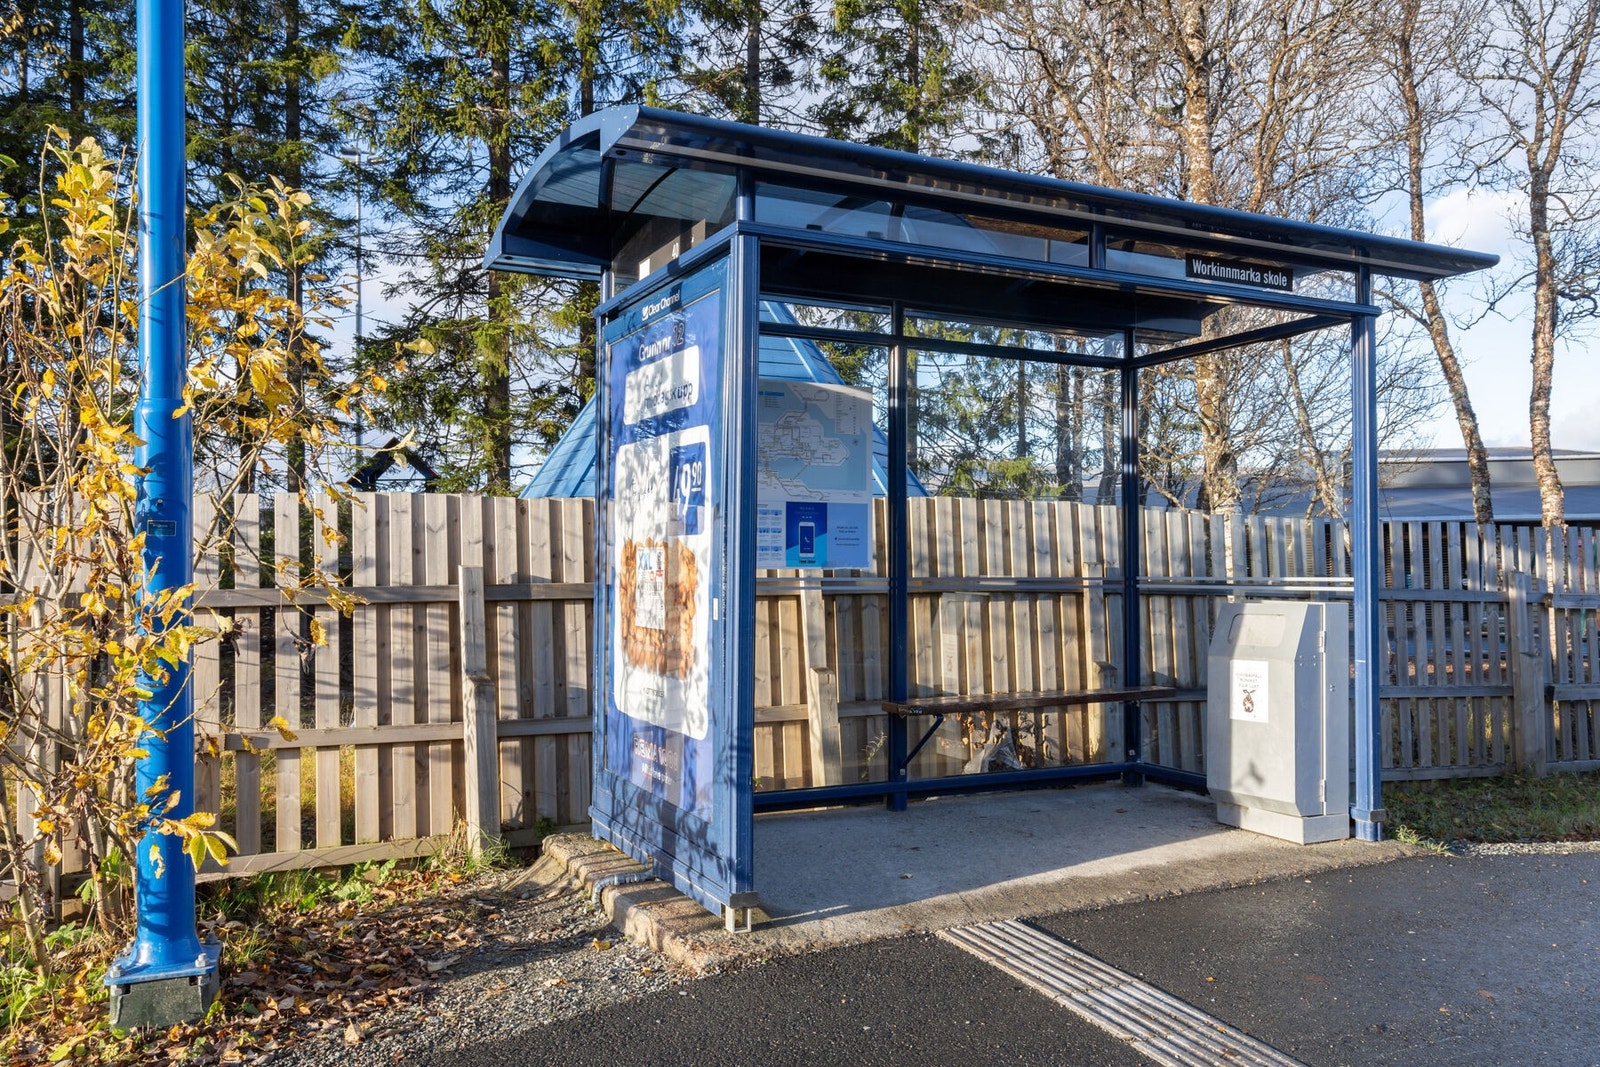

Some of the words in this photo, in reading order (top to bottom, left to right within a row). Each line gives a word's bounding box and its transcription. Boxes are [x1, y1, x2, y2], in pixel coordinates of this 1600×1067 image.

[1192, 258, 1261, 283] Workinnmarka
[1263, 270, 1288, 287] skole
[638, 341, 661, 362] Grunn
